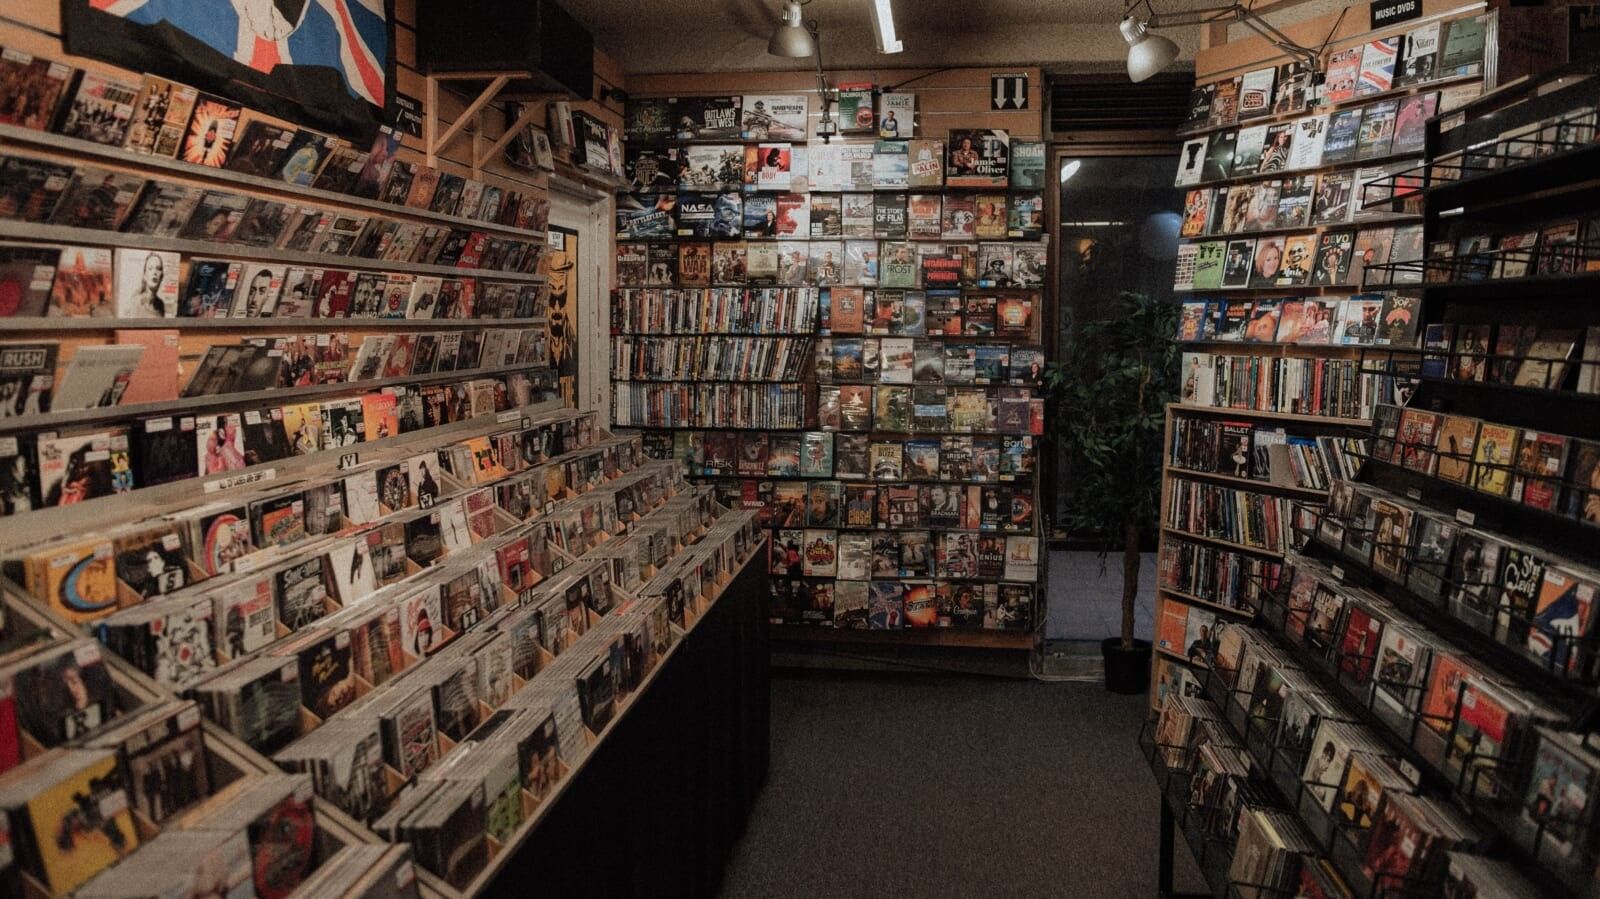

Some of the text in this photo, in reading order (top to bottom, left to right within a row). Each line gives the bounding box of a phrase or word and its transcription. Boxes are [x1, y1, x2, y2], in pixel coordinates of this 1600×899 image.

[1375, 1, 1415, 20] MUSIC DVDS
[704, 108, 736, 119] OUTLAWS
[718, 118, 736, 128] WEST
[969, 158, 996, 168] Jamie
[976, 165, 1006, 174] Oliver
[681, 203, 714, 213] NASA
[876, 214, 904, 222] OF FILM
[1322, 233, 1349, 245] DEVO
[683, 260, 707, 273] WAR
[886, 264, 911, 274] FROST
[3, 352, 42, 366] RUSH
[1223, 425, 1249, 434] BALLET
[705, 459, 733, 468] RISK
